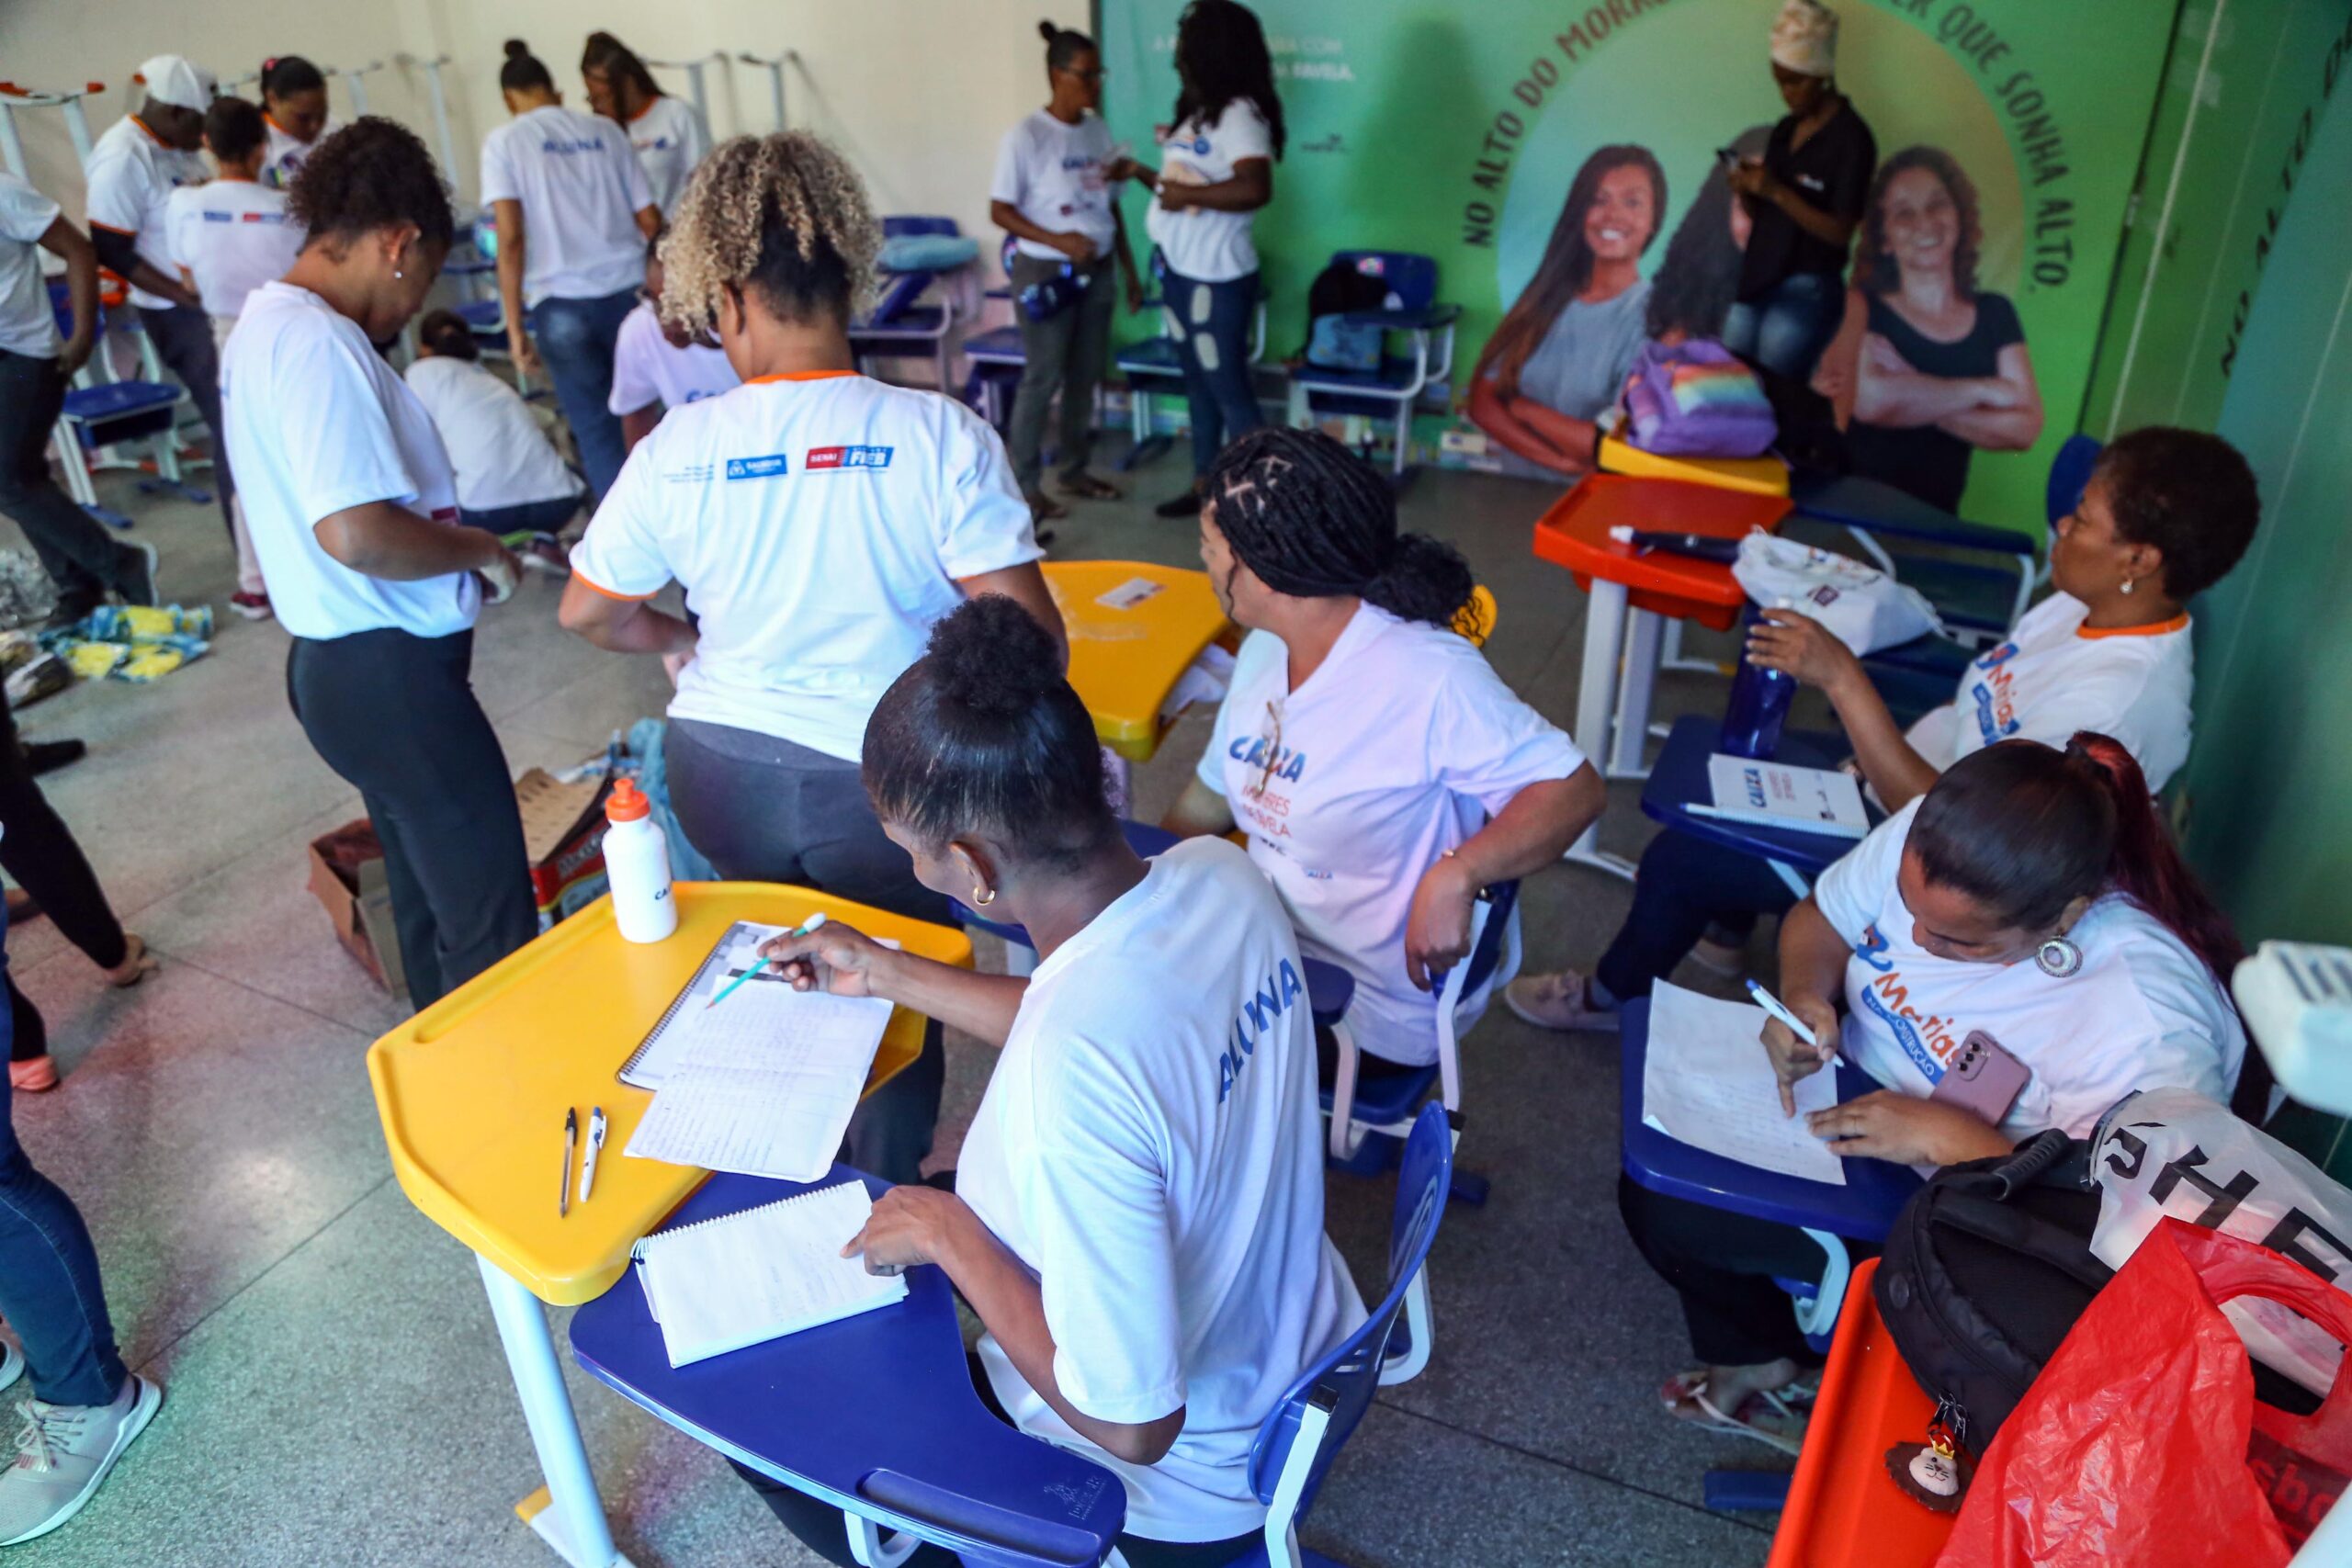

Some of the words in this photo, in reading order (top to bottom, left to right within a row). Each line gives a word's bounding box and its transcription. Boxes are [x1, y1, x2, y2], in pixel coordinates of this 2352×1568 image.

[1936, 5, 2010, 73] QUE
[1513, 57, 1559, 108] DO
[1472, 110, 1524, 191] ALTO
[1995, 71, 2069, 187] SONHA
[1463, 201, 1496, 248] NO
[1229, 737, 1306, 784] CAXA
[1219, 958, 1302, 1104] ALUNA
